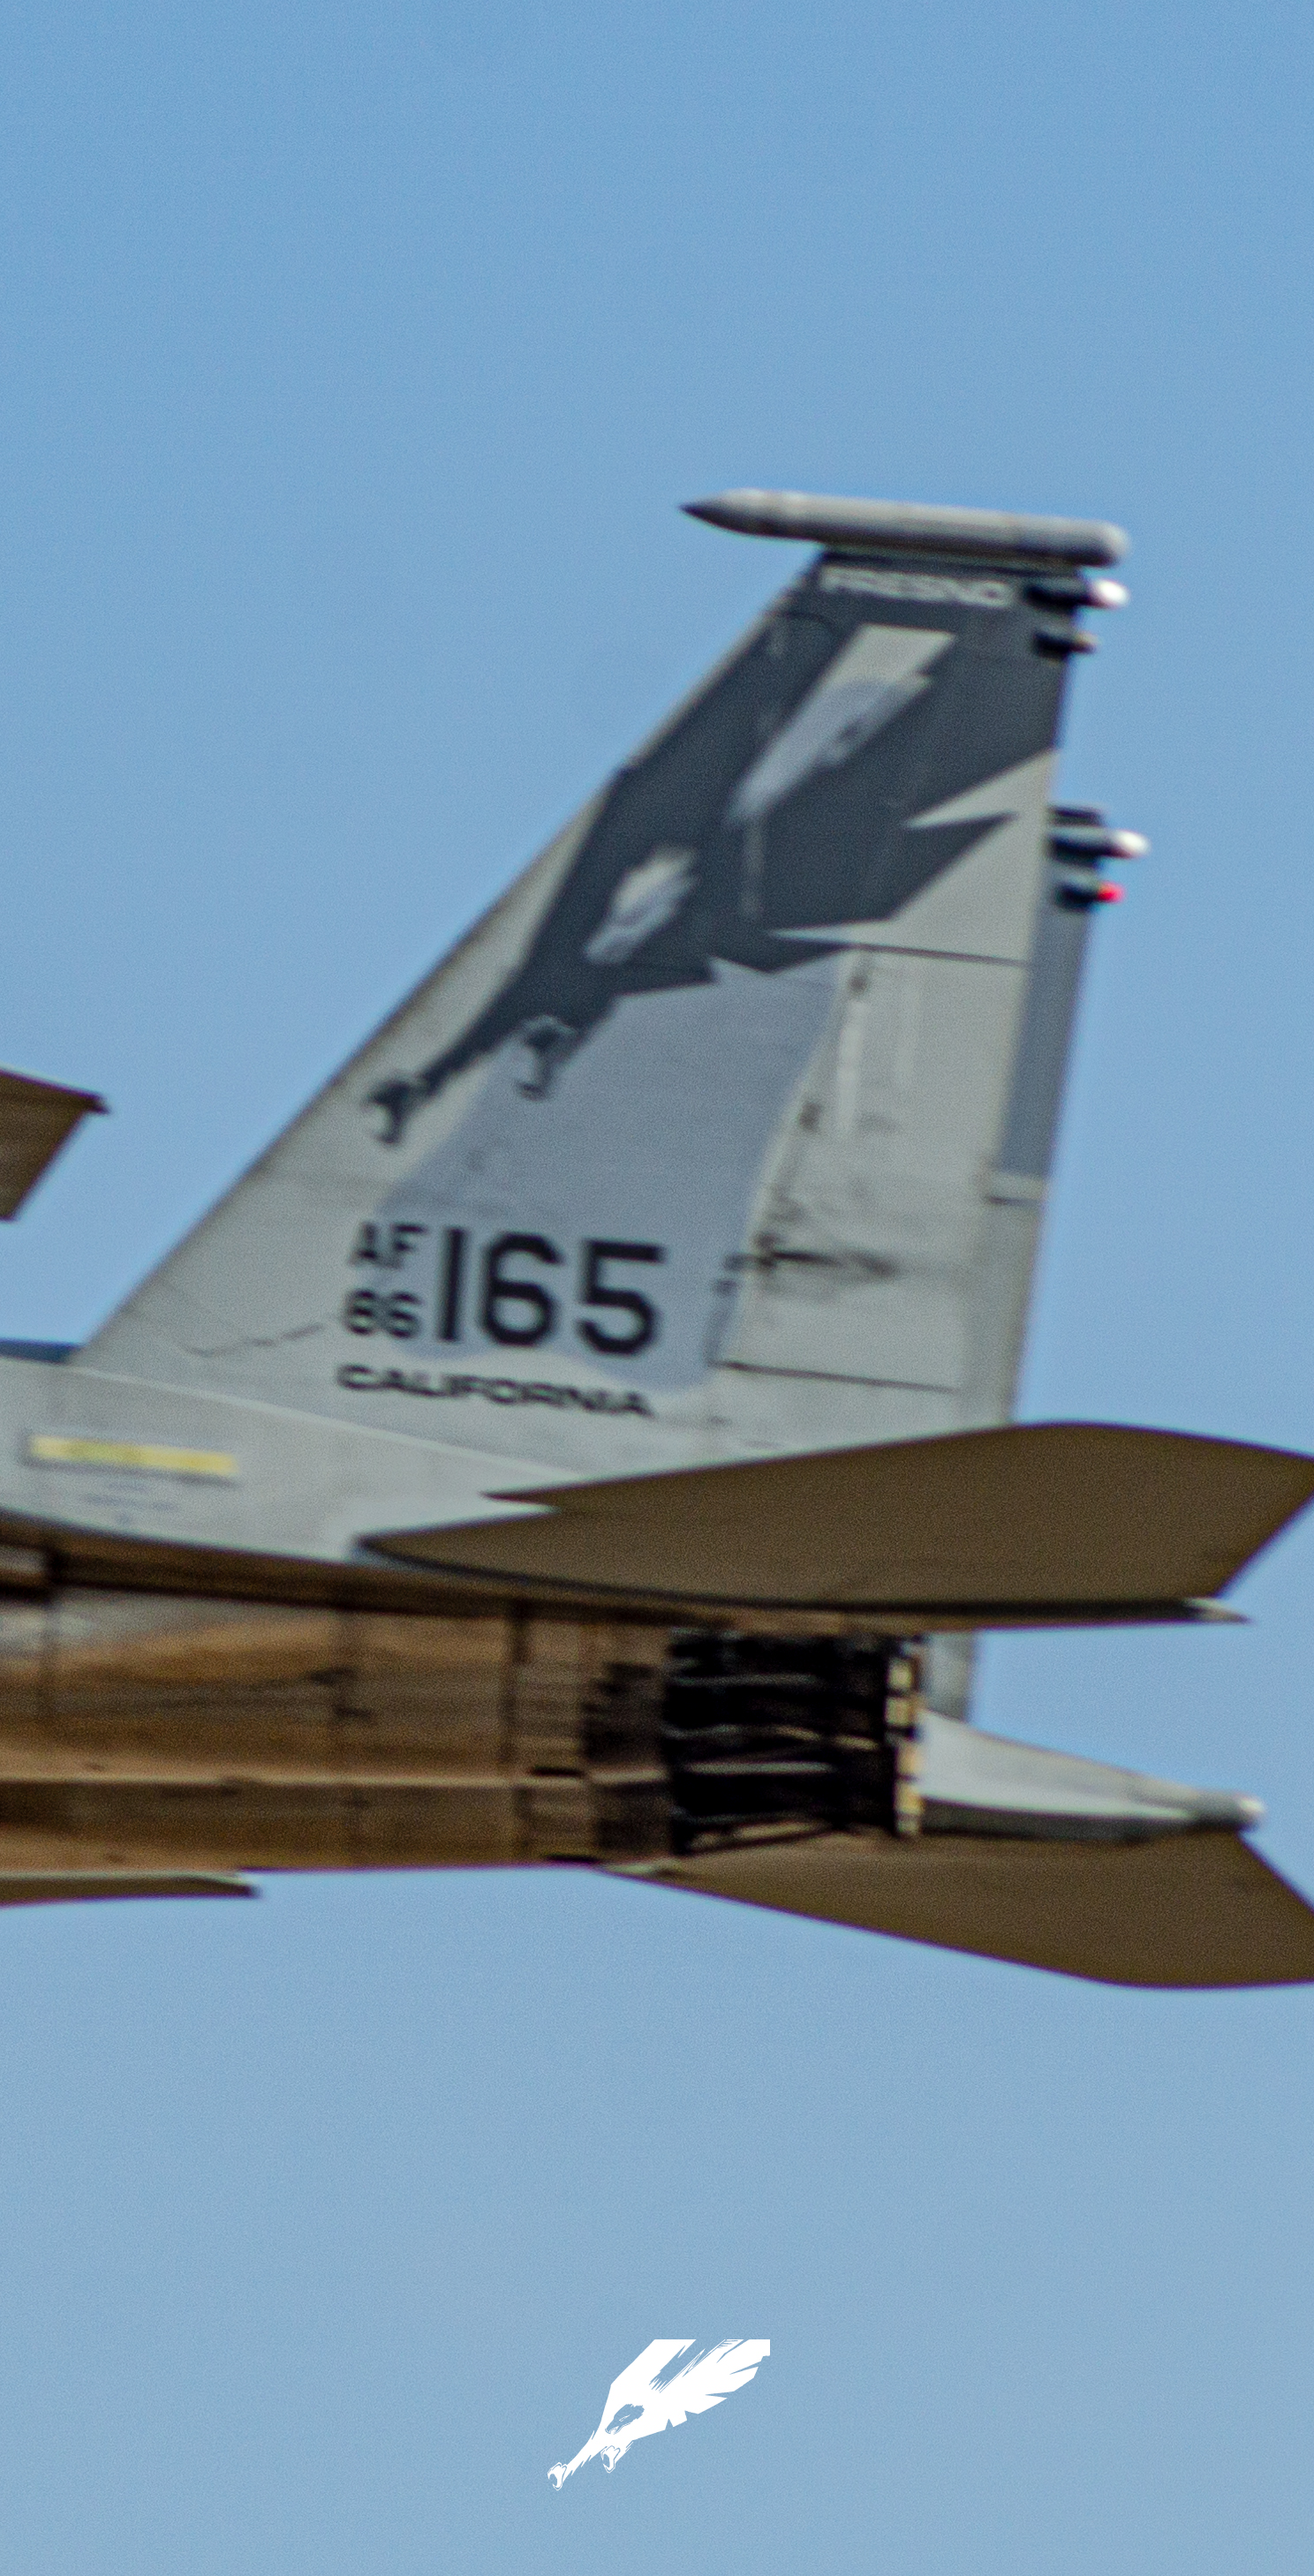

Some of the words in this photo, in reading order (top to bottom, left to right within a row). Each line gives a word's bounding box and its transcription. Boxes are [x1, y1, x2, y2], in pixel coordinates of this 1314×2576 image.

[819, 565, 1014, 608] FRESNO
[351, 1222, 427, 1269] AF
[344, 1289, 423, 1339] 86
[439, 1227, 668, 1357] 165
[336, 1363, 655, 1419] CALIFORNIA
